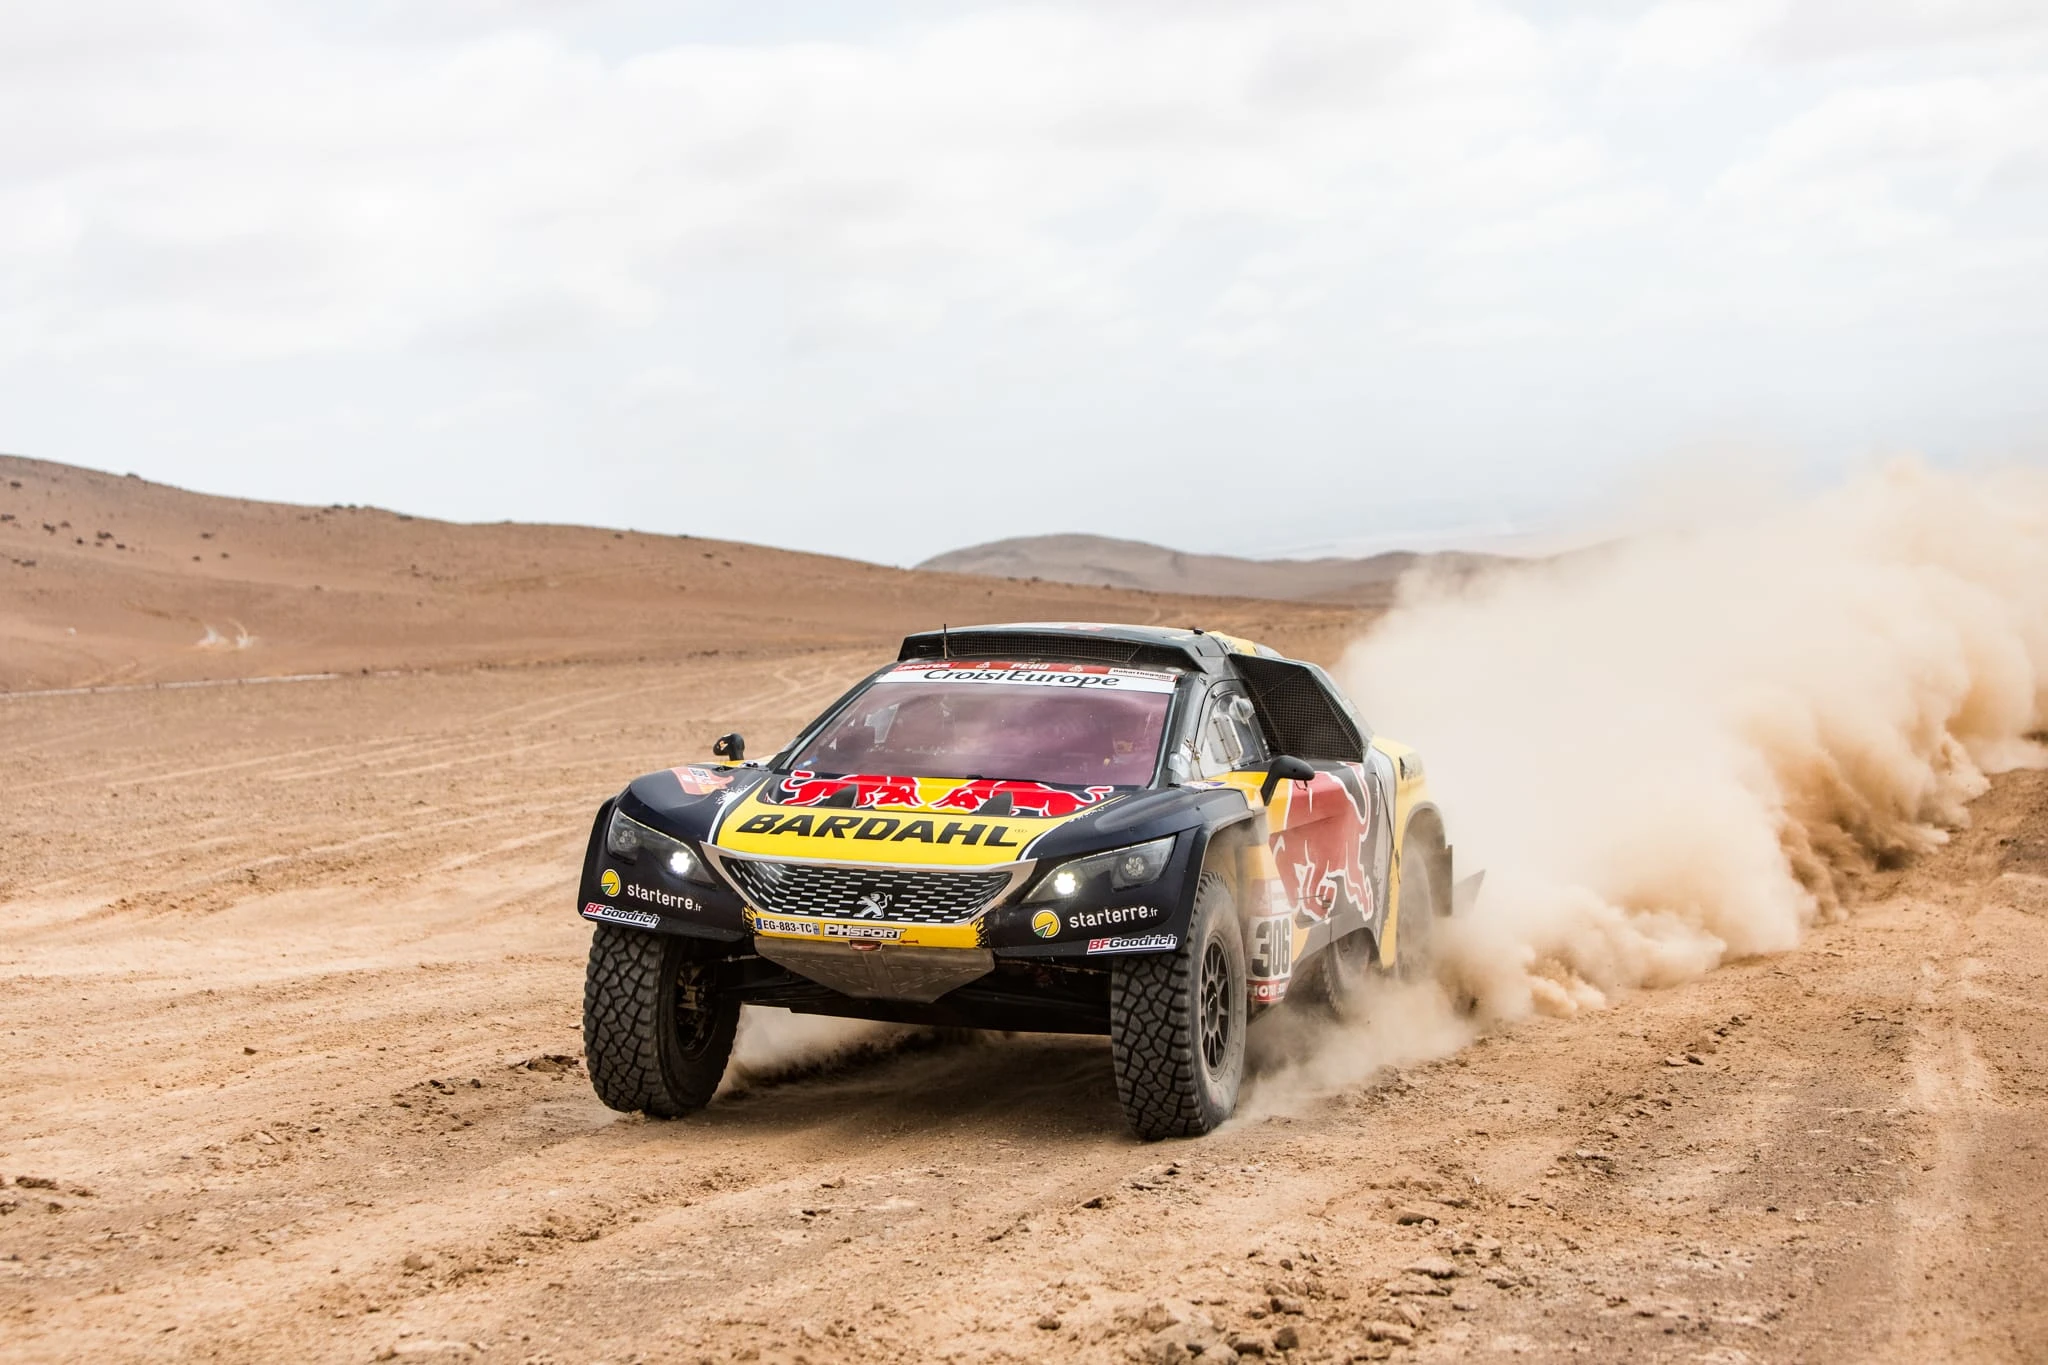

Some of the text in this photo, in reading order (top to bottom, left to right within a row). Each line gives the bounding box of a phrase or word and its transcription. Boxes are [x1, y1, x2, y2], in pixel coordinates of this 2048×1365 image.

[923, 669, 1121, 688] CroisiEurope
[735, 813, 1018, 847] BARDAHL
[585, 902, 661, 924] BFGoodrich
[1069, 905, 1158, 929] starterre.fr
[763, 918, 812, 933] EG-883-TC
[1088, 934, 1177, 950] BFGoodrich
[1251, 918, 1290, 978] 306
